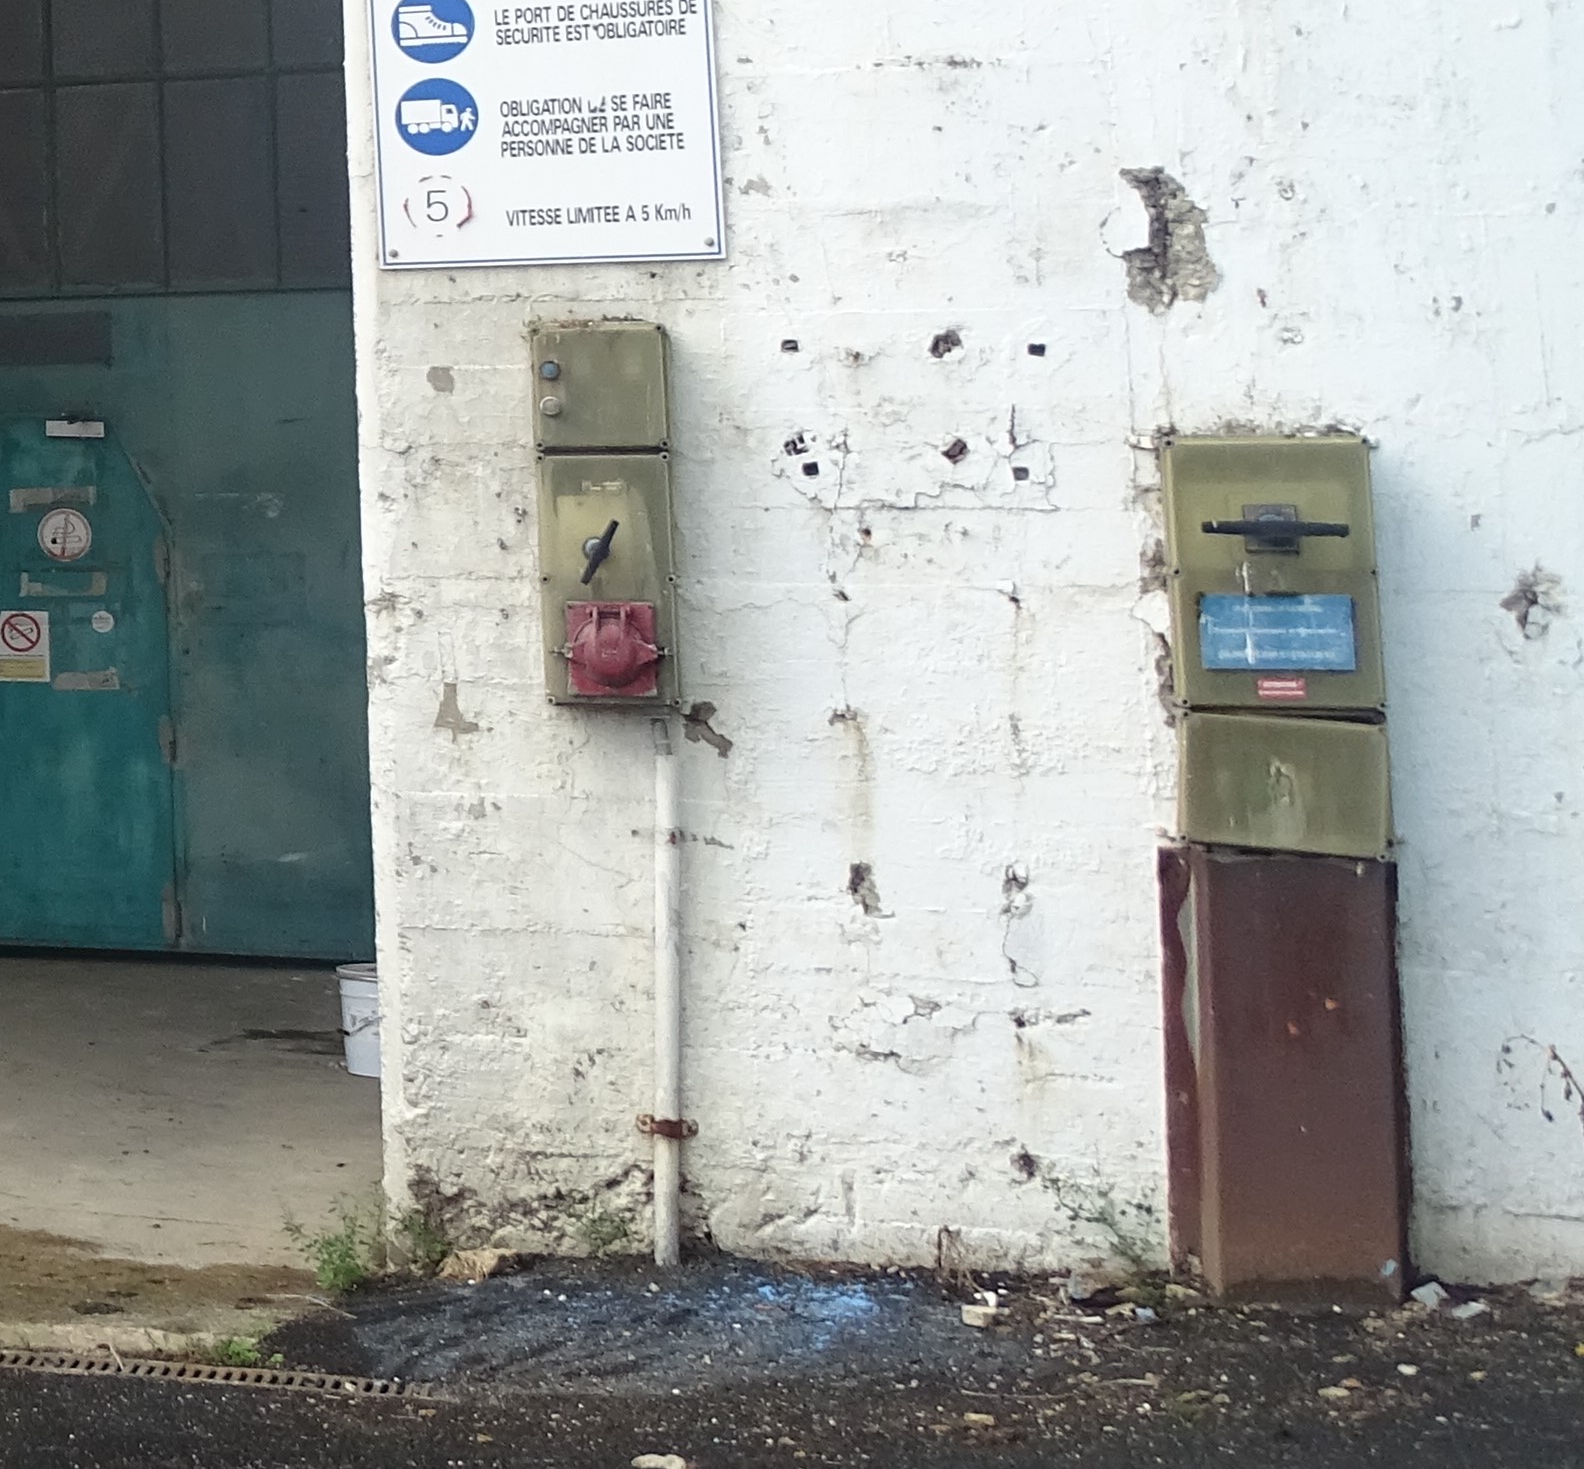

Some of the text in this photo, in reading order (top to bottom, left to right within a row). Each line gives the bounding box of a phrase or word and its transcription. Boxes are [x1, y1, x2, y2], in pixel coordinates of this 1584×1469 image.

[494, 9, 510, 25] LE
[515, 6, 551, 24] PORT
[557, 4, 575, 22] DE
[496, 18, 686, 45] SECURITE EST OBLIGATOIRE
[500, 97, 582, 118] OBLIGATION
[611, 94, 627, 112] SE
[632, 92, 672, 110] FAIRE
[501, 112, 675, 138] ACCOMPAGNER PAR UNE
[501, 132, 685, 158] PERSONNE DE LA SOCIETE
[425, 189, 450, 222] 5
[506, 202, 692, 227] VITESSE LIMITEE A 5 Km/h
